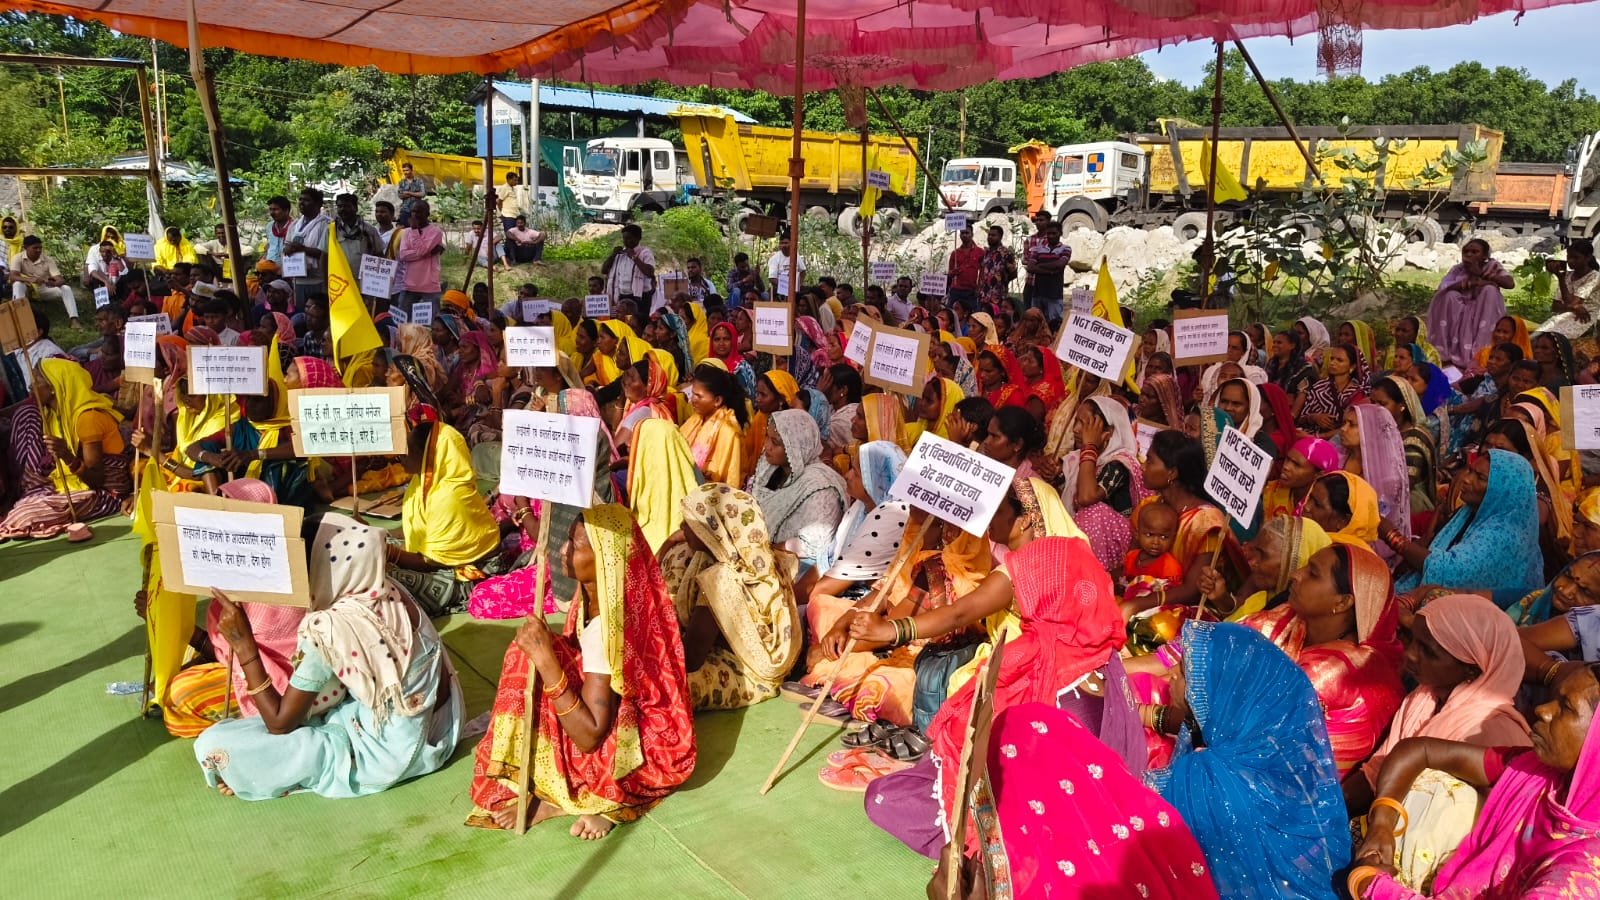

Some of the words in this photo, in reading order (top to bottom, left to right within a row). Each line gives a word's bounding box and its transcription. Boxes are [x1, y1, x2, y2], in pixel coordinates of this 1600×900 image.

[1072, 315, 1091, 330] NGT
[1090, 320, 1115, 340] नियम
[1114, 332, 1128, 345] का
[1073, 333, 1097, 351] पालन
[1097, 342, 1114, 358] करो
[1068, 349, 1092, 366] पालन
[1091, 357, 1108, 373] करो
[919, 442, 931, 460] भू
[929, 443, 976, 473] विस्थापितों
[971, 460, 984, 477] के
[982, 468, 1006, 488] साथ
[1225, 430, 1242, 452] HPC
[1240, 441, 1253, 461] दर
[1250, 450, 1264, 470] का
[919, 463, 937, 481] भेद
[935, 472, 956, 488] भाव
[953, 479, 982, 502] करना
[1219, 452, 1240, 480] पालन
[1238, 470, 1256, 494] करो
[907, 481, 922, 498] बंद
[920, 488, 940, 507] करो
[938, 495, 954, 513] बंद
[952, 503, 974, 522] करो
[1210, 475, 1232, 503] पालन
[1230, 493, 1248, 517] करो
